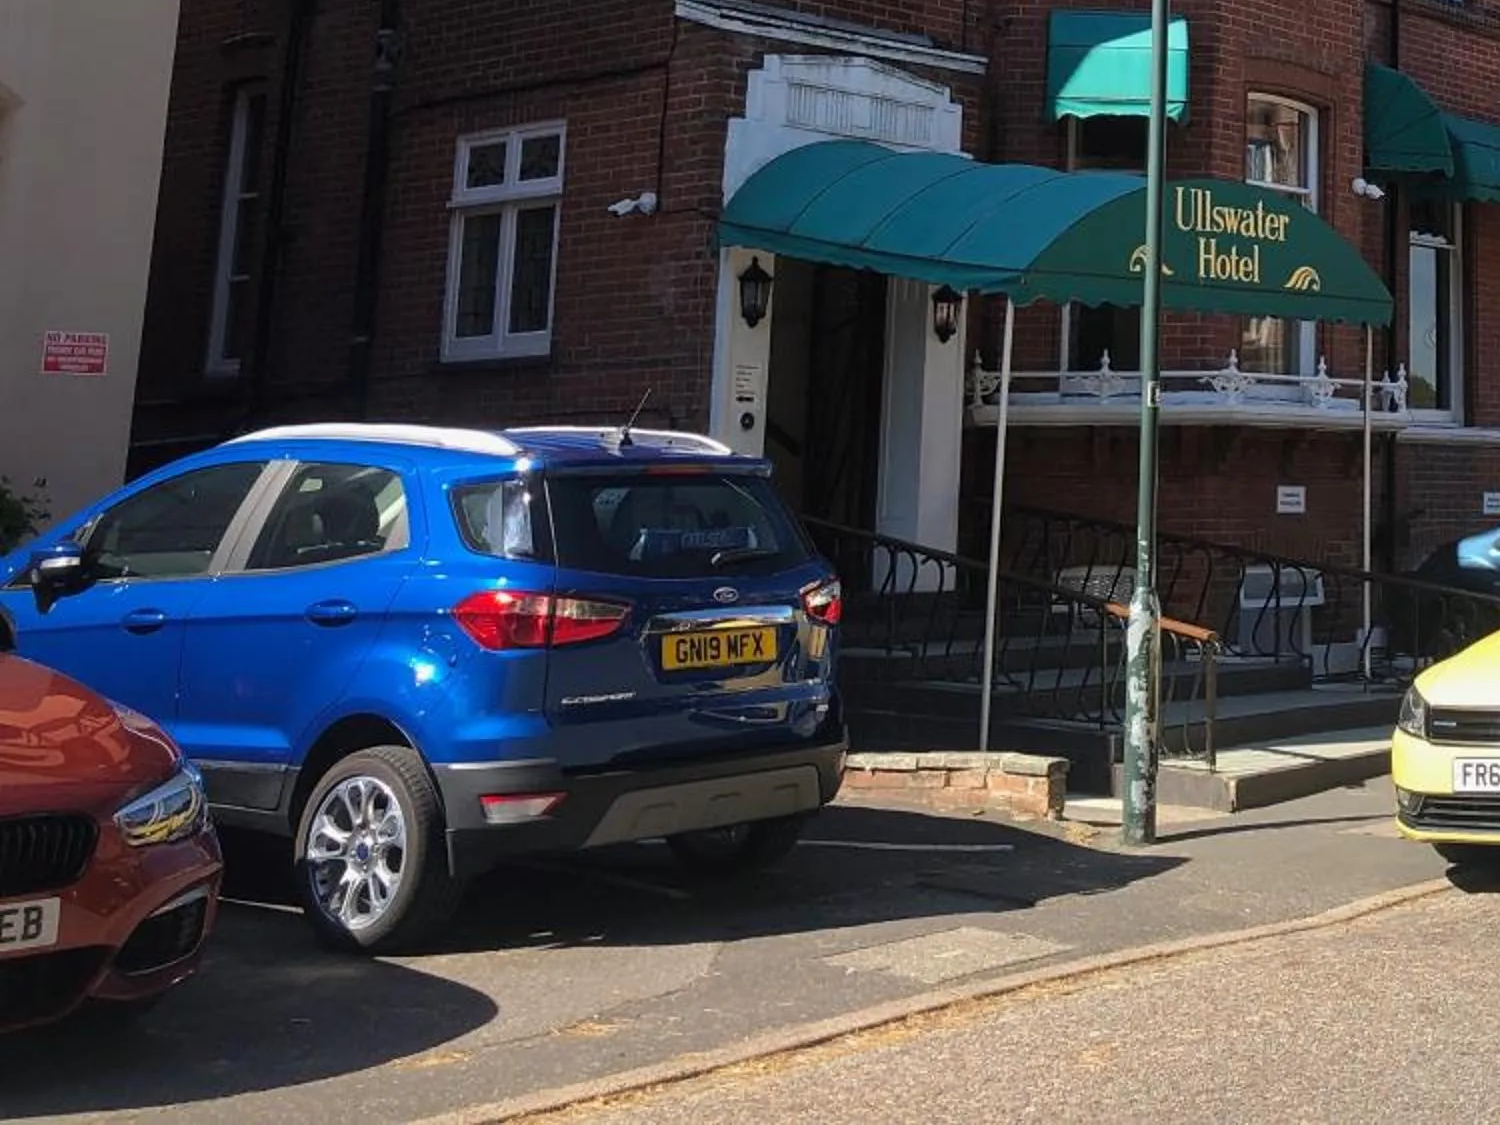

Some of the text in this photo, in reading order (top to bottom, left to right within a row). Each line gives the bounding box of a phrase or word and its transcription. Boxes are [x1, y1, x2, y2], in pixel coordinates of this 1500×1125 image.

[1175, 186, 1290, 242] Ullswater
[1198, 235, 1261, 284] Hotel
[675, 631, 766, 665] GN19 MFX
[0, 906, 43, 944] EB
